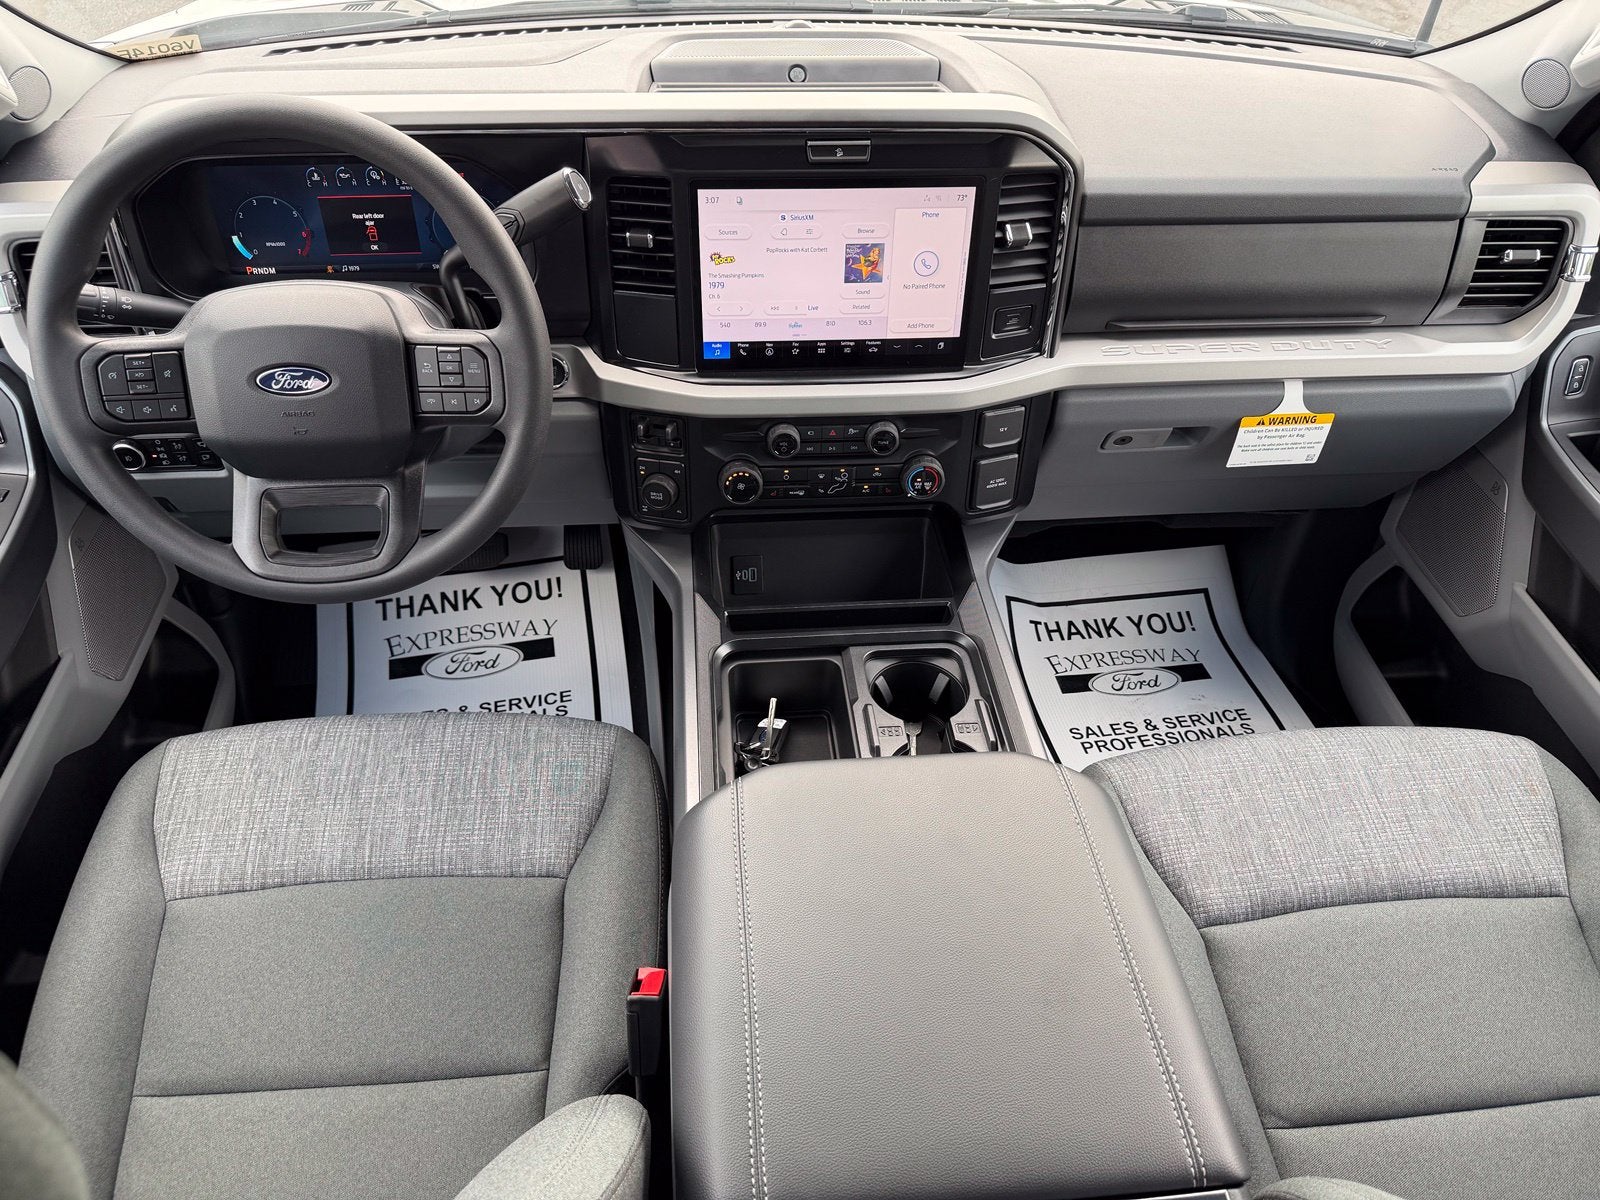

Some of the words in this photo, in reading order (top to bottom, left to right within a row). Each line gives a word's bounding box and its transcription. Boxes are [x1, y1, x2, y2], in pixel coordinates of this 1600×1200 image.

[1100, 341, 1261, 357] SUPER
[1271, 338, 1392, 352] DUTY
[272, 371, 314, 389] Ford
[1268, 416, 1317, 425] WARNING
[375, 587, 482, 621] THANK
[490, 576, 563, 606] YOU!
[1030, 616, 1124, 642] THANK
[1126, 611, 1196, 636] YOU!
[445, 651, 501, 675] Ford
[1111, 672, 1162, 692] Ford
[479, 690, 572, 713] SERVICE
[1069, 721, 1138, 740] SALES
[1144, 718, 1160, 731] &
[1162, 708, 1251, 729] SERVICE
[1080, 723, 1256, 754] PROFESSIONALS
